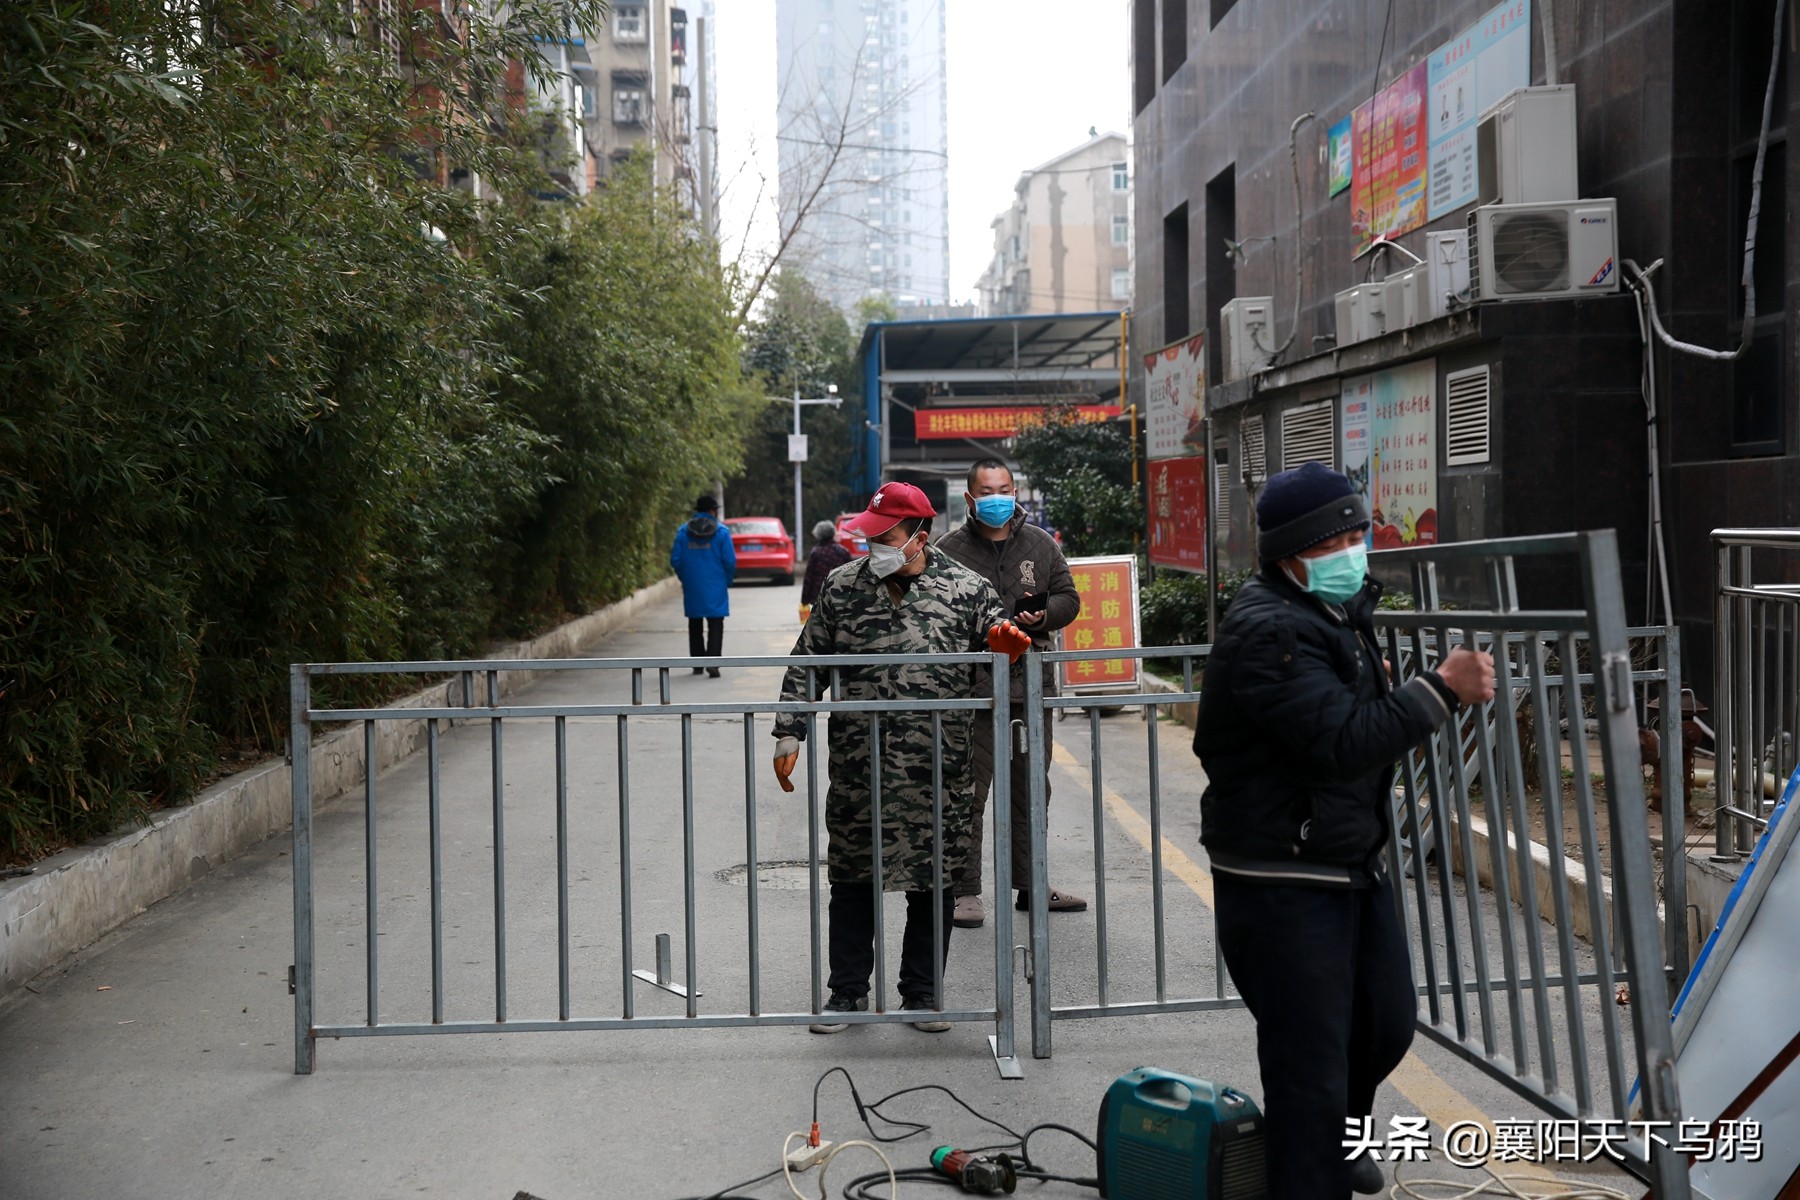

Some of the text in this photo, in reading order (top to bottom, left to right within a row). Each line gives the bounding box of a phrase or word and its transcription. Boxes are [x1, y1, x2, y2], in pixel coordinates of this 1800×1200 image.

[1073, 573, 1096, 677] 禁止停车
[1100, 571, 1124, 675] 消防通道
